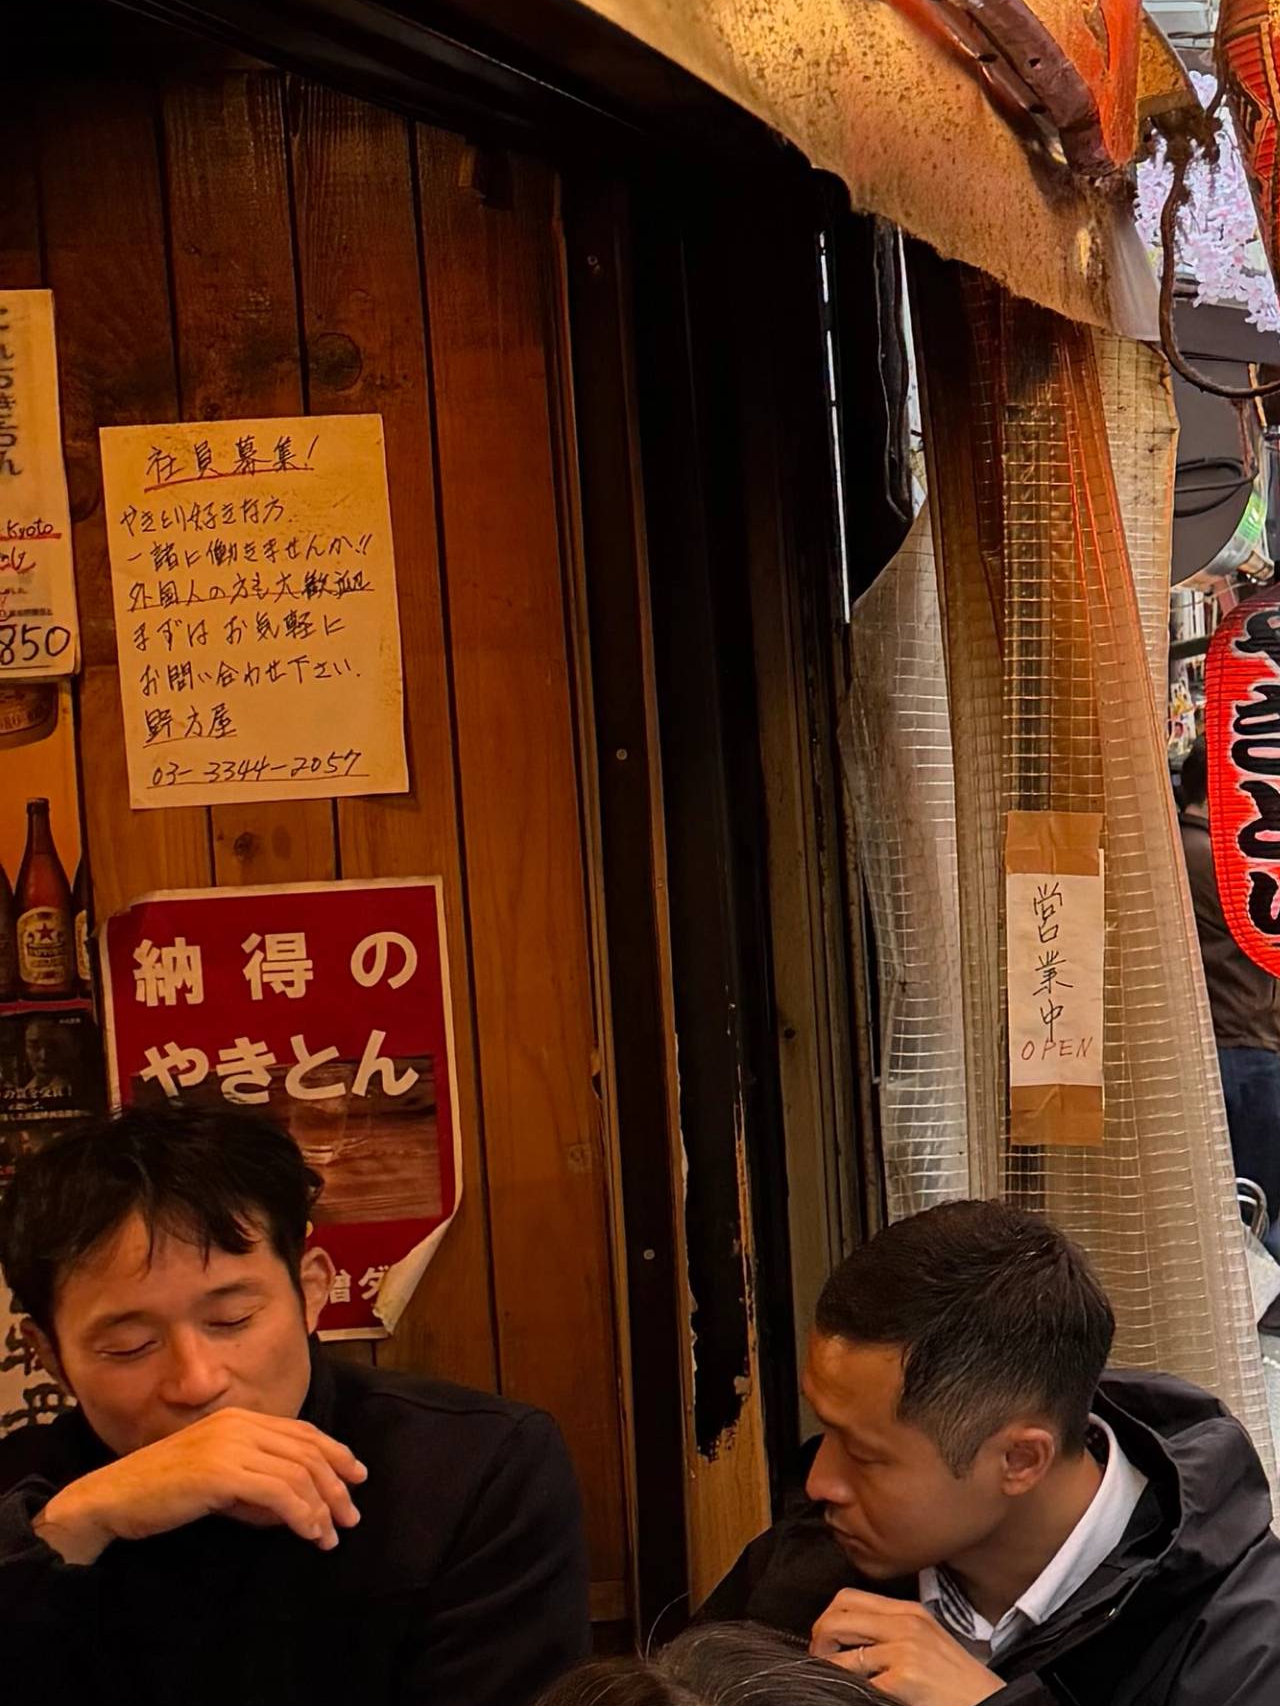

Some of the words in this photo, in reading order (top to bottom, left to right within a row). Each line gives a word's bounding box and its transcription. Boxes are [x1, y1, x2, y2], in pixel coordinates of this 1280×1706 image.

[7, 517, 55, 541] Kyoto
[132, 930, 420, 1008] 納得の
[1032, 881, 1074, 1043] 営業中
[139, 1029, 421, 1105] やきとん
[1020, 1036, 1094, 1062] OPEN
